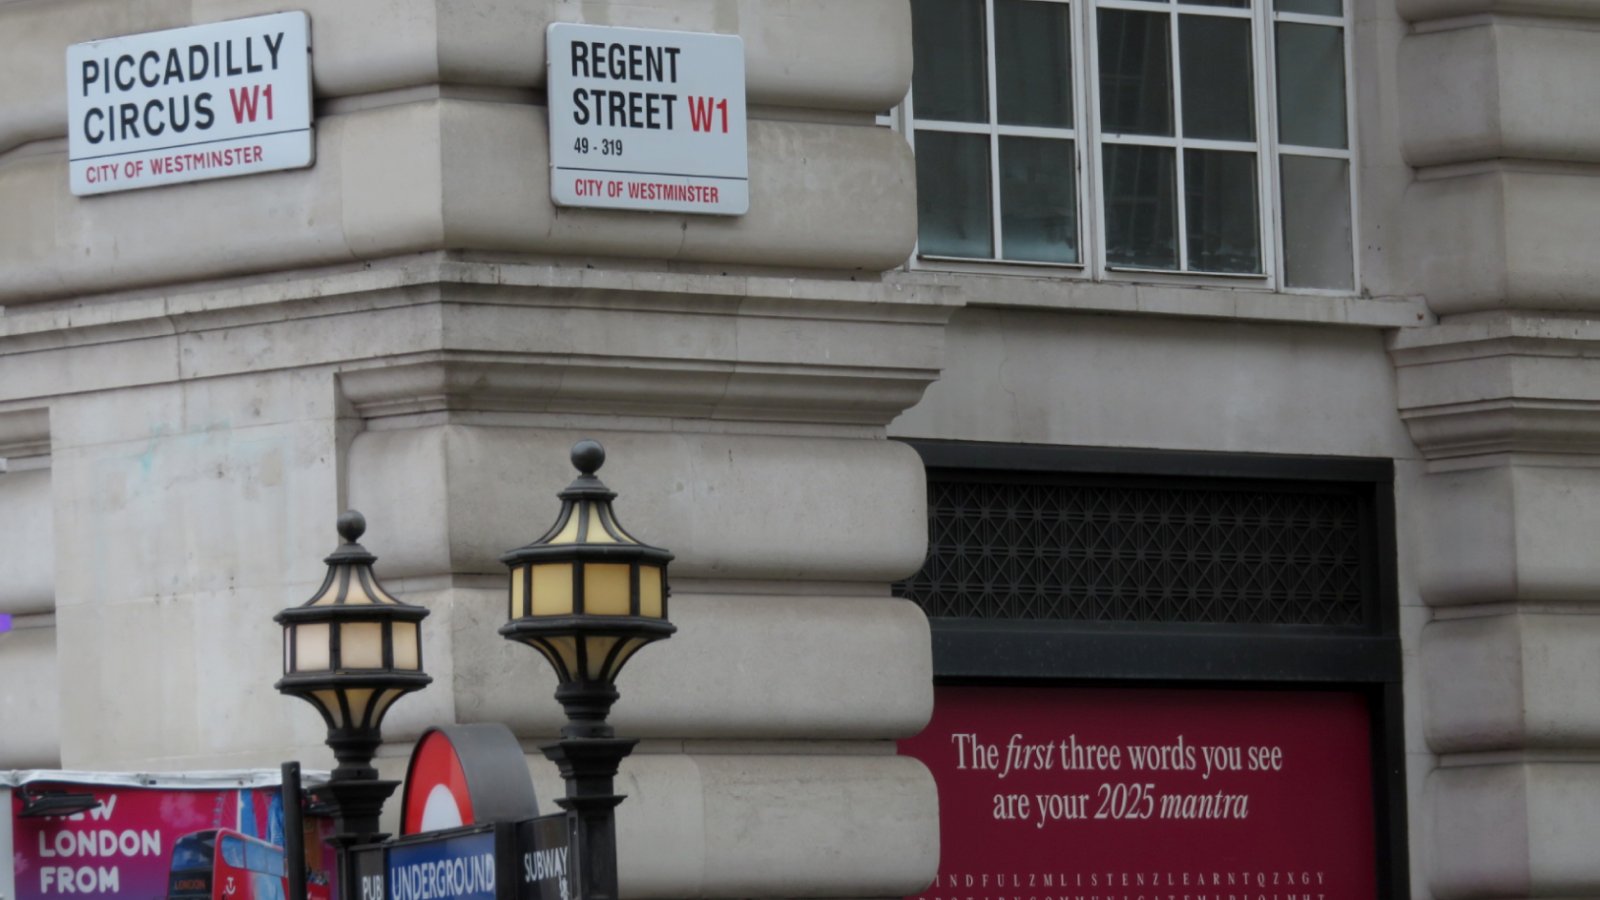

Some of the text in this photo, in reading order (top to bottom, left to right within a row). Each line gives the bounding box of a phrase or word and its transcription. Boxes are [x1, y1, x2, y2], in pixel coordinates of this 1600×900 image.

[82, 32, 285, 97] PICCADILLY
[571, 41, 681, 83] REGENT
[83, 84, 273, 144] CIRCUS W1
[573, 88, 728, 133] STREET W1
[86, 145, 263, 183] CITY OF WESTMINSTER
[574, 137, 589, 154] 49
[601, 138, 623, 156] 319
[575, 179, 719, 203] CITY OF WESTMINSTER
[952, 733, 1283, 779] The first three words you see
[993, 783, 1249, 828] are your 2025 mantra
[38, 829, 161, 858] LONDON
[524, 846, 568, 883] SUBWAY
[40, 866, 120, 894] FROM
[392, 852, 496, 900] UNDERGROUND
